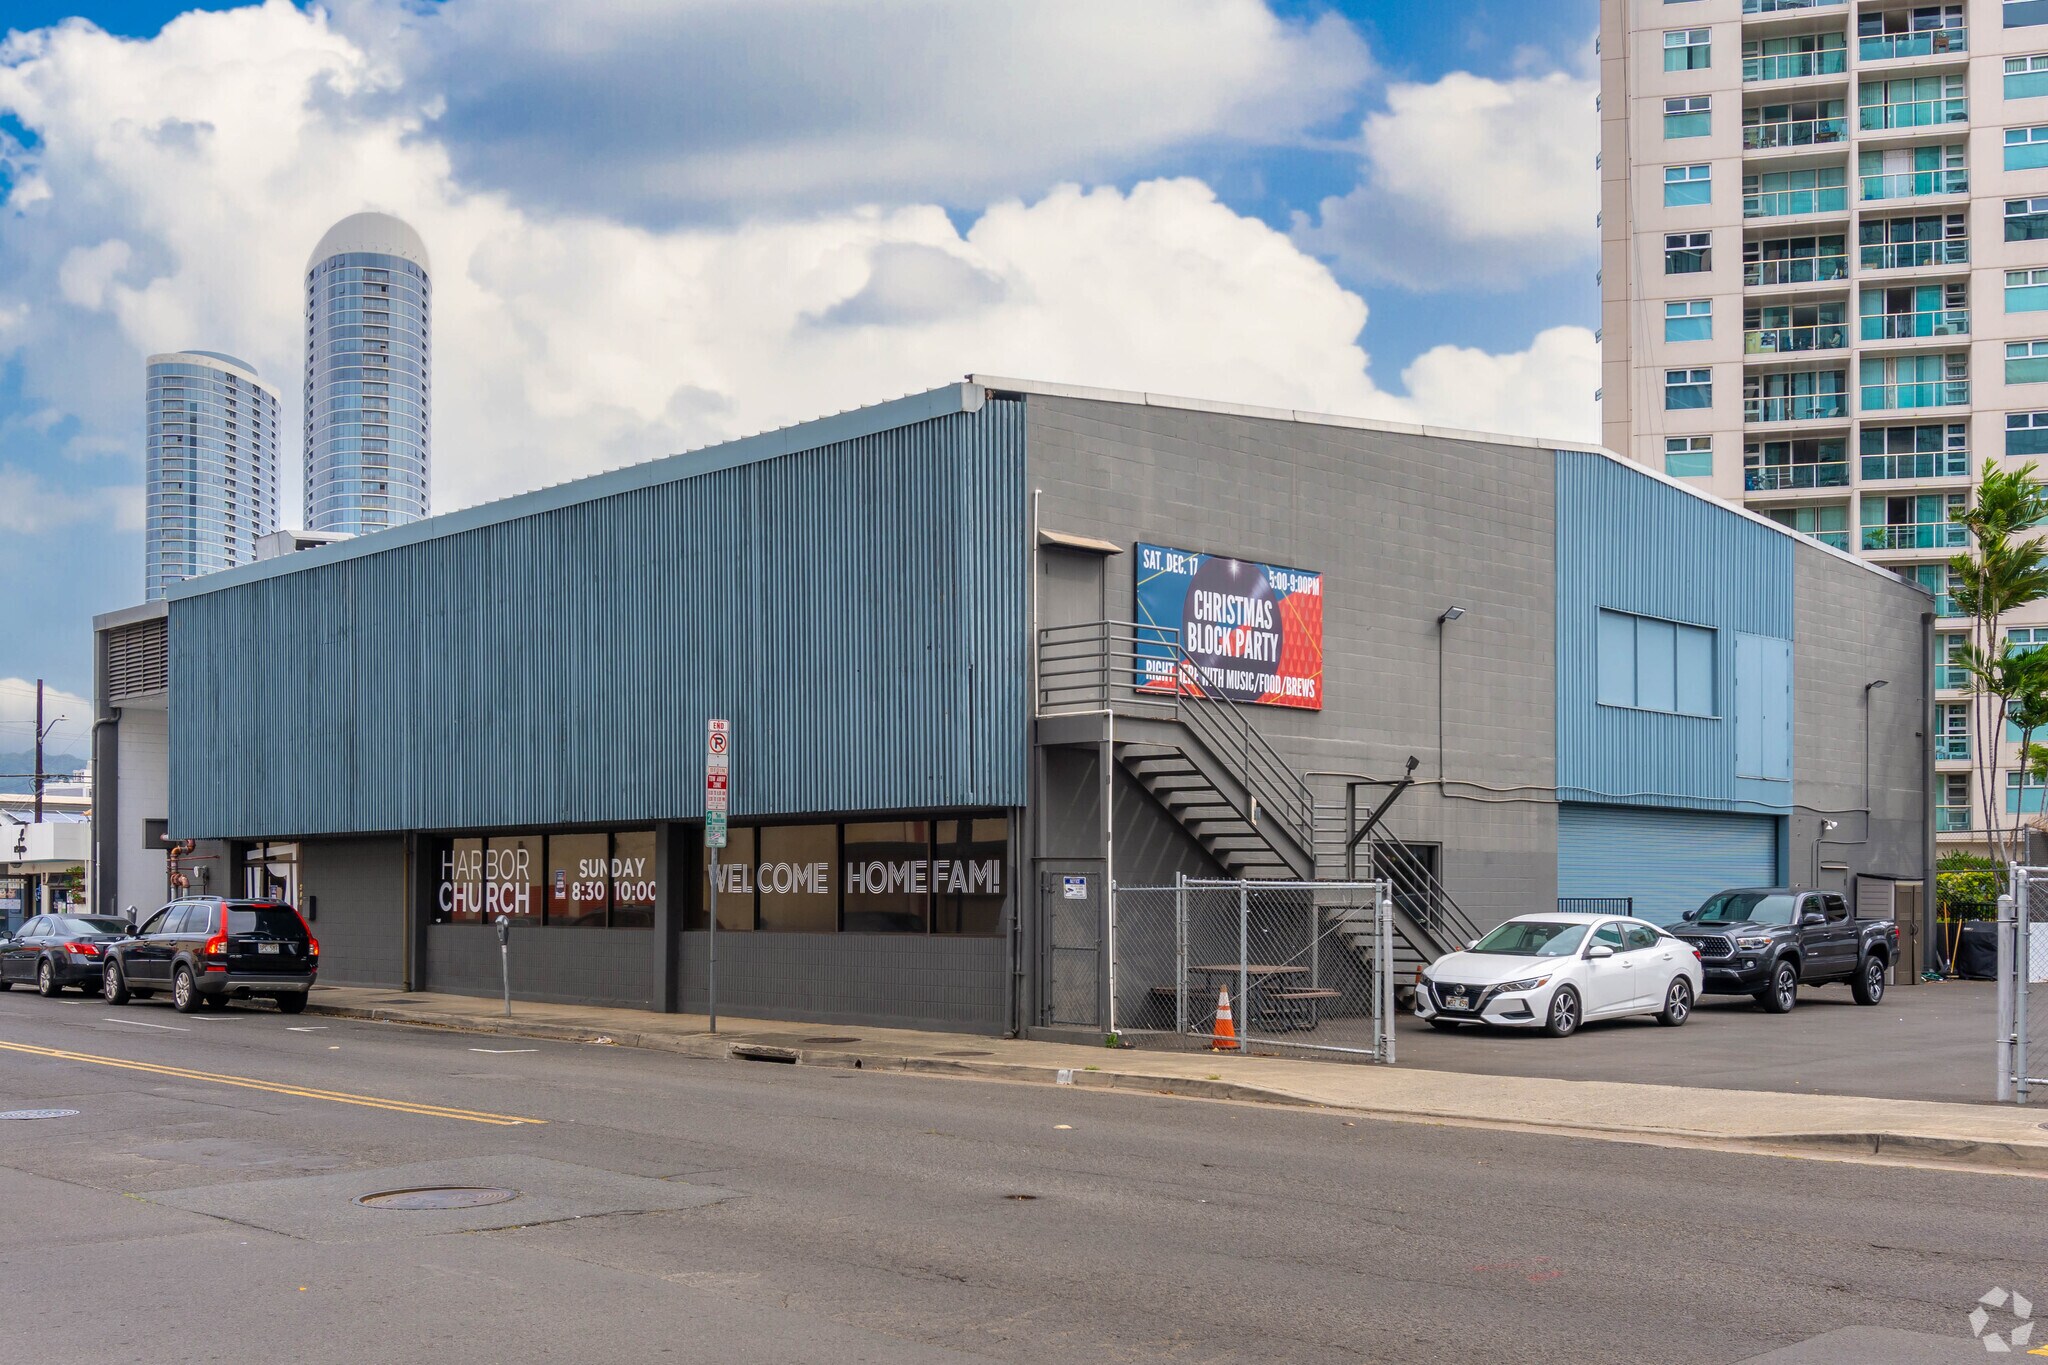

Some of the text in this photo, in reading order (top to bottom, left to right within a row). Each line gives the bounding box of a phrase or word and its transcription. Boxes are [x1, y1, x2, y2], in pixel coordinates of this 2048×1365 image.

[1143, 549, 1199, 576] SAT. DEC. 17
[1269, 570, 1320, 596] 5:00-9:00PM
[1194, 589, 1273, 630] CHRISTMAS
[1187, 621, 1279, 662] BLOCK PARTY
[1145, 660, 1175, 683] RIGHT
[1200, 666, 1224, 688] WITH
[1226, 669, 1315, 698] MUSIC/FOOD/BREWS
[713, 722, 725, 730] END
[441, 848, 530, 881] HARBOR
[579, 857, 646, 878] SUNDAY
[707, 859, 1000, 894] WELCOME HOME FAM!
[438, 881, 530, 914] CHURCH
[571, 881, 605, 901] 8:30
[613, 880, 656, 901] 10:00
